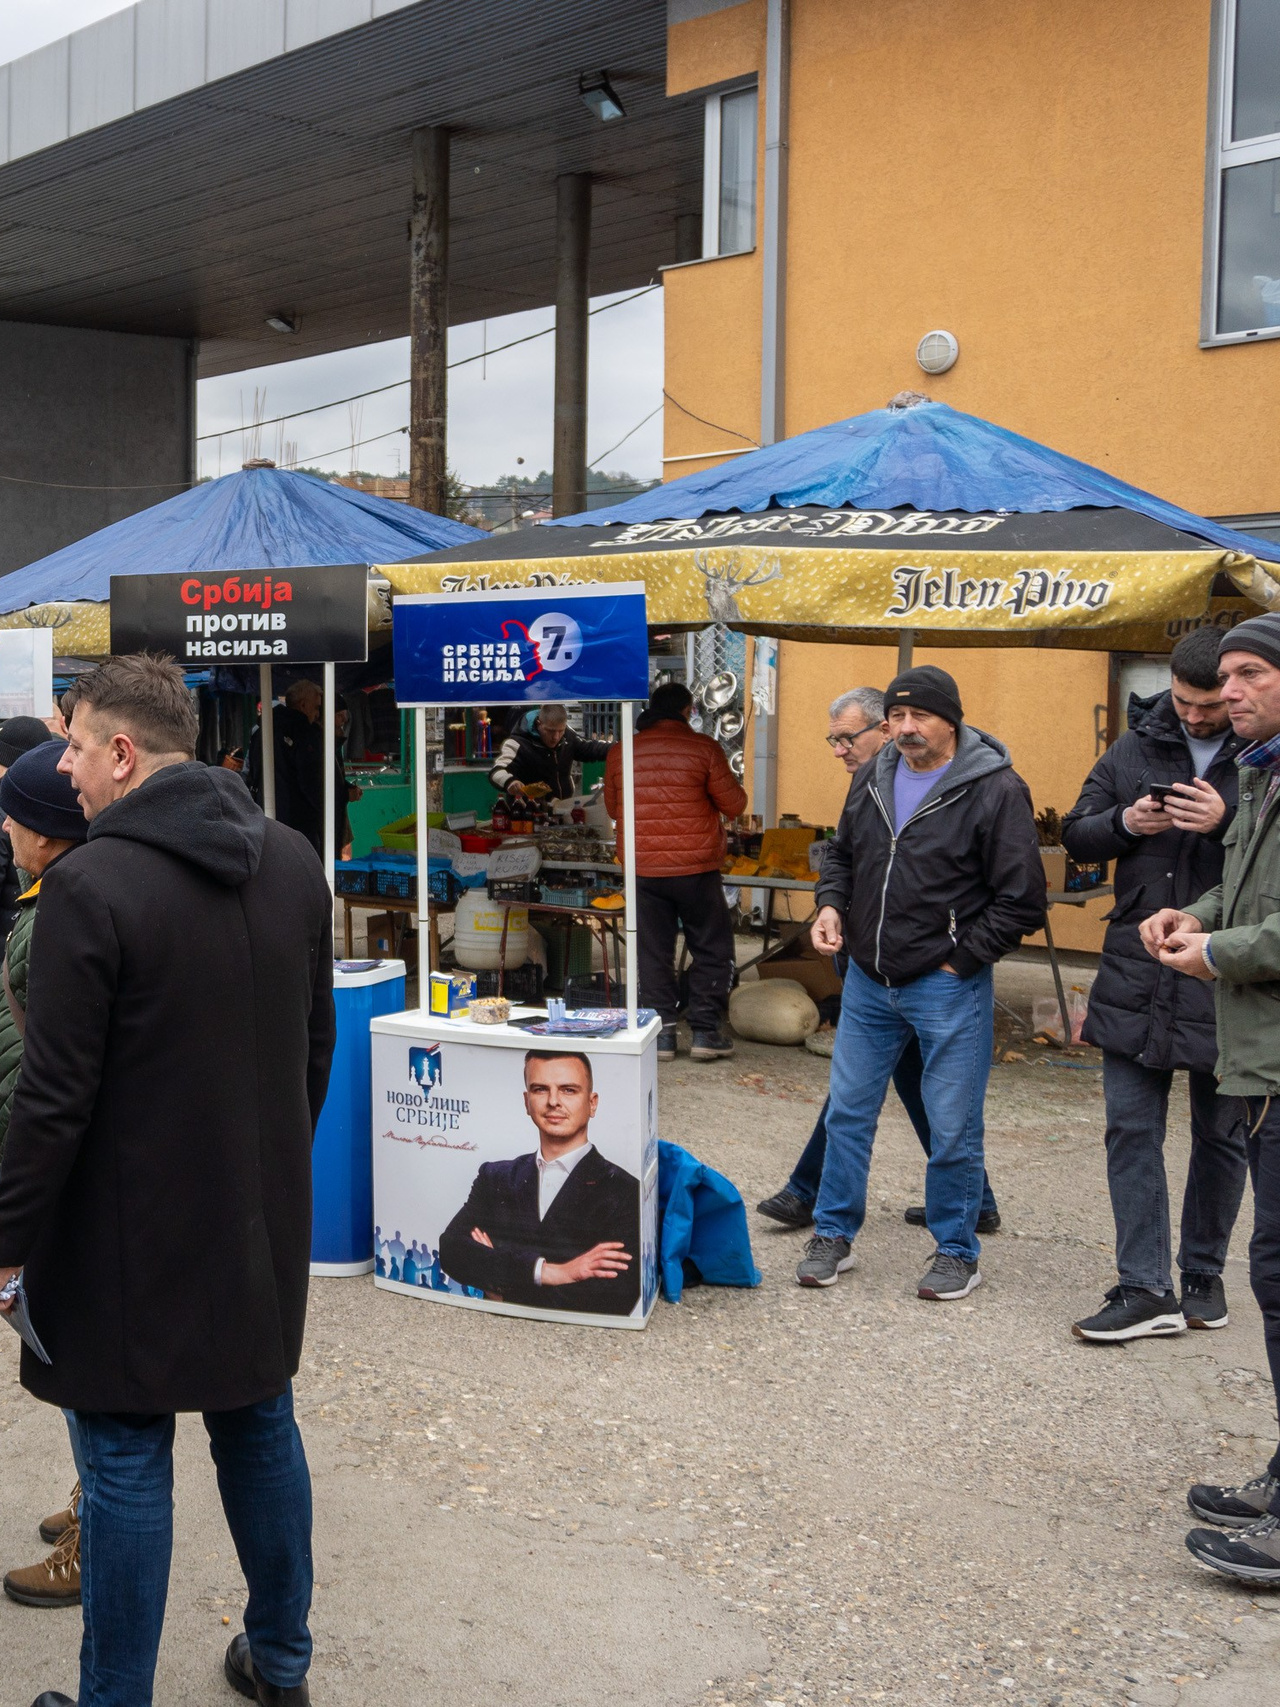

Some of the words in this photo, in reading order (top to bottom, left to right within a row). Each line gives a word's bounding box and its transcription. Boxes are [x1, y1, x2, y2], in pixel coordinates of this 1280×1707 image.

[180, 576, 293, 611] Србија
[884, 566, 1008, 618] Jelen
[1003, 567, 1115, 618] Pivo
[186, 613, 286, 637] против
[186, 639, 288, 656] насиља
[443, 643, 521, 656] СРБИЈА
[542, 626, 572, 660] 7.
[443, 656, 521, 669] ПРОТИВ
[443, 669, 526, 682] НАСИЉА
[387, 1090, 423, 1108] НОВО
[429, 1096, 470, 1115] ЛИЦЕ
[396, 1106, 460, 1132] СРБИЈЕ
